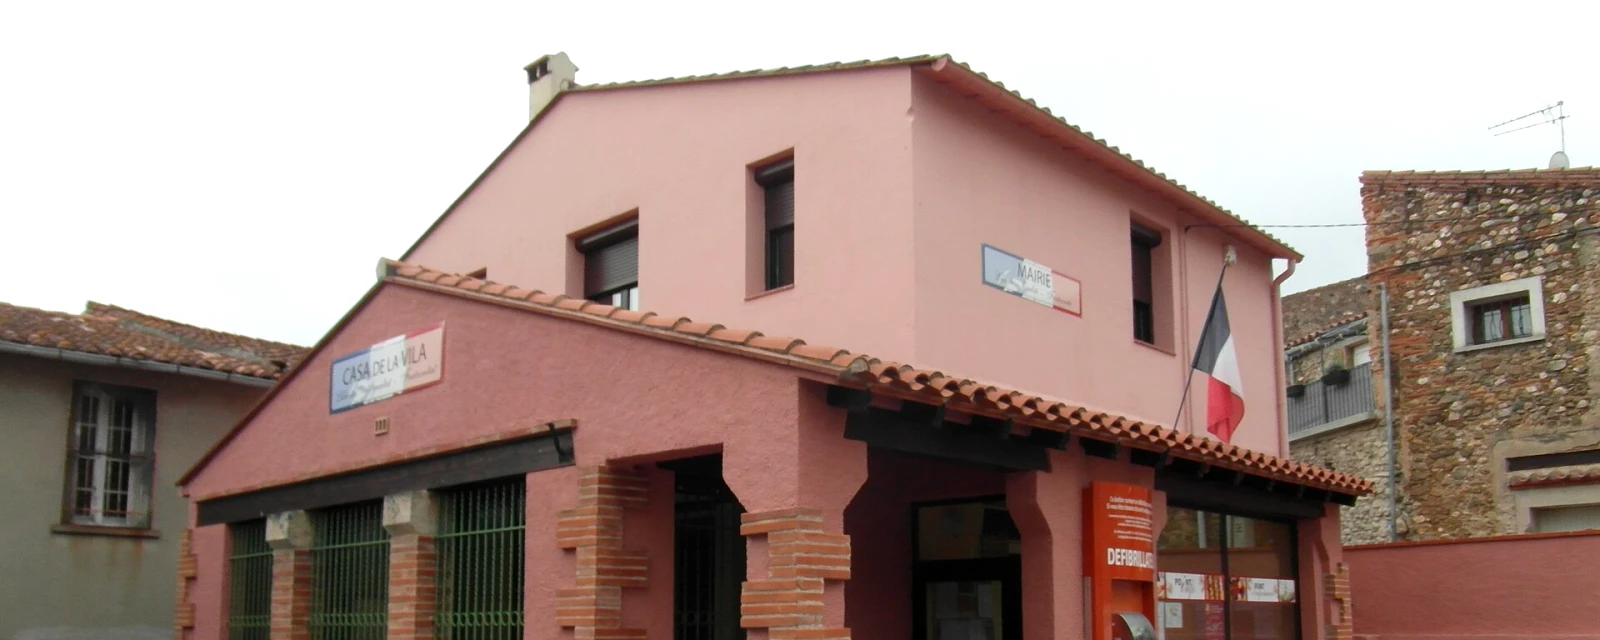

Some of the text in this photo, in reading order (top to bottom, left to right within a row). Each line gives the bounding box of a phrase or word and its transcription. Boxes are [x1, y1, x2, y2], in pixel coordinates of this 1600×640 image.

[1018, 262, 1051, 288] MAIRIE
[342, 361, 370, 386] CASA
[373, 359, 385, 376] DE
[387, 354, 399, 372] LA
[401, 343, 427, 367] VILA
